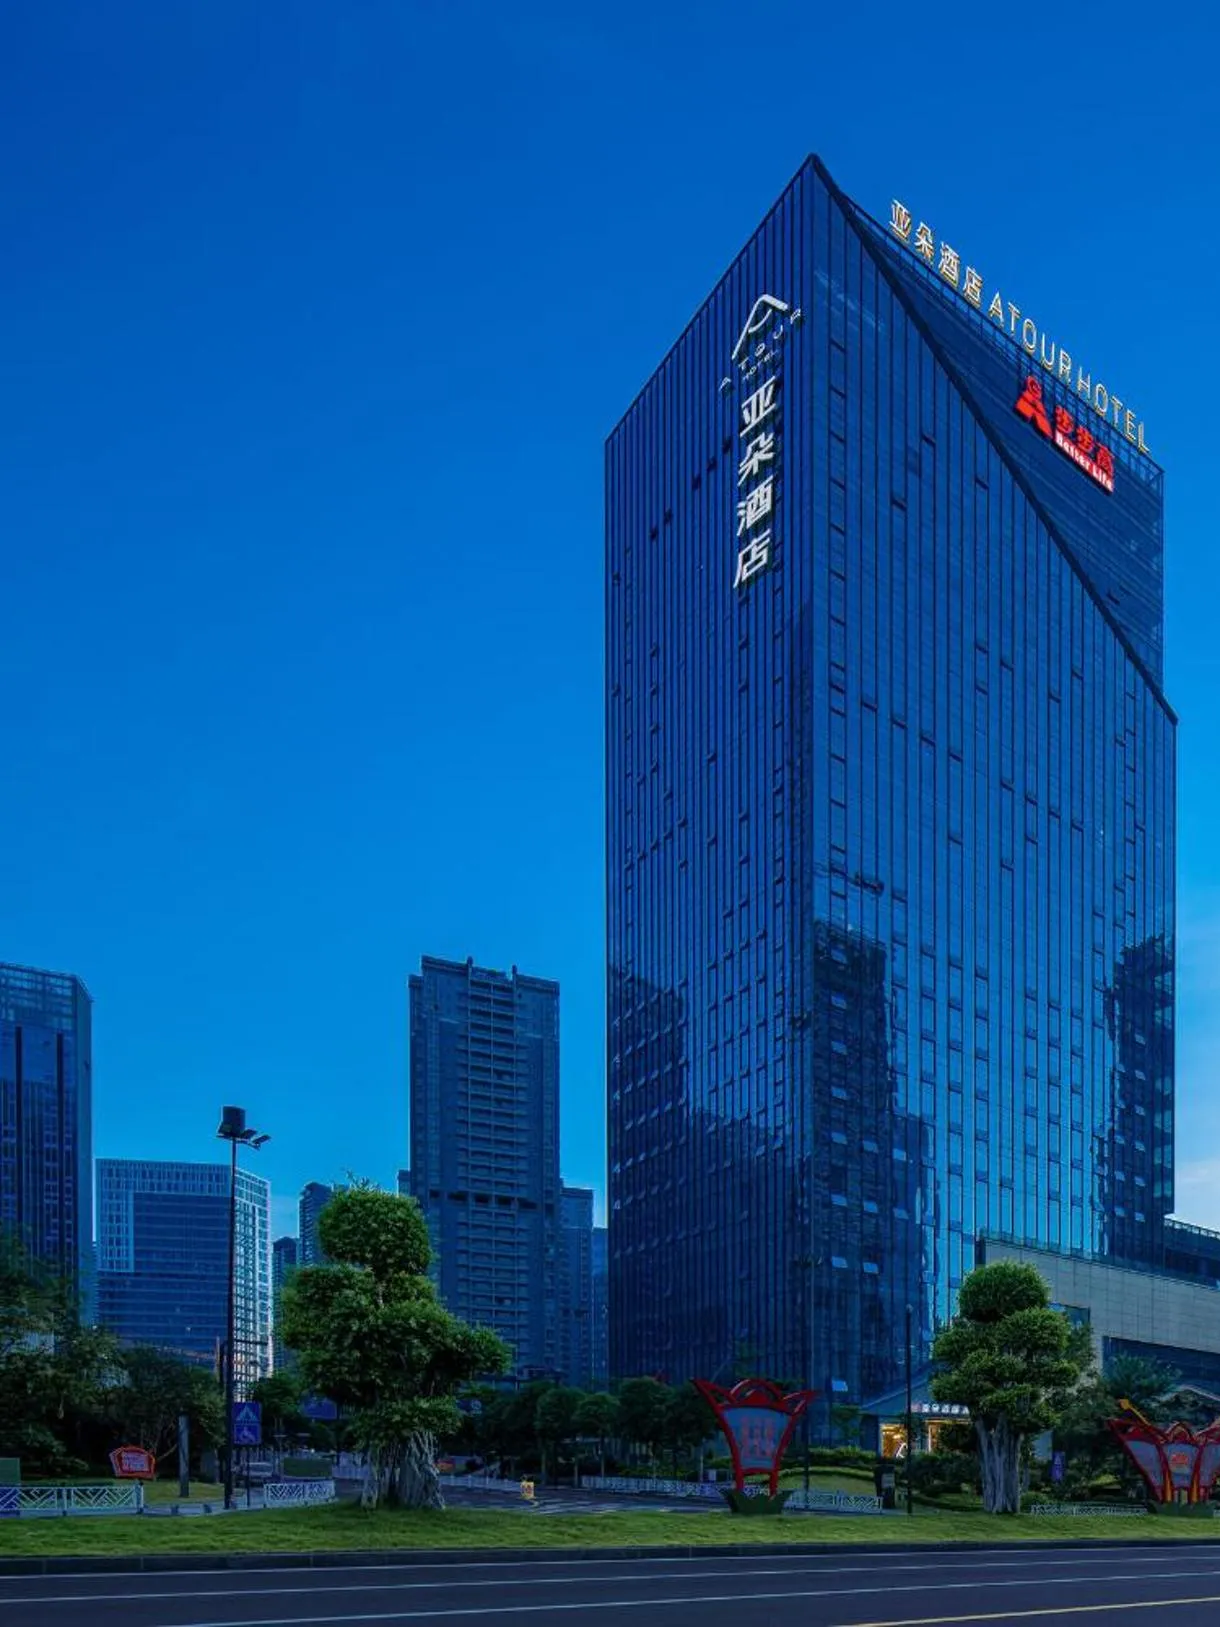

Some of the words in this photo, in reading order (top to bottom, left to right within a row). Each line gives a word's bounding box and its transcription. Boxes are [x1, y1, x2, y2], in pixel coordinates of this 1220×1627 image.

[889, 198, 983, 309] 亚朵酒店
[989, 291, 1072, 384] ATOUR
[1077, 366, 1151, 455] HOTEL
[733, 375, 777, 589] 亚朵酒店
